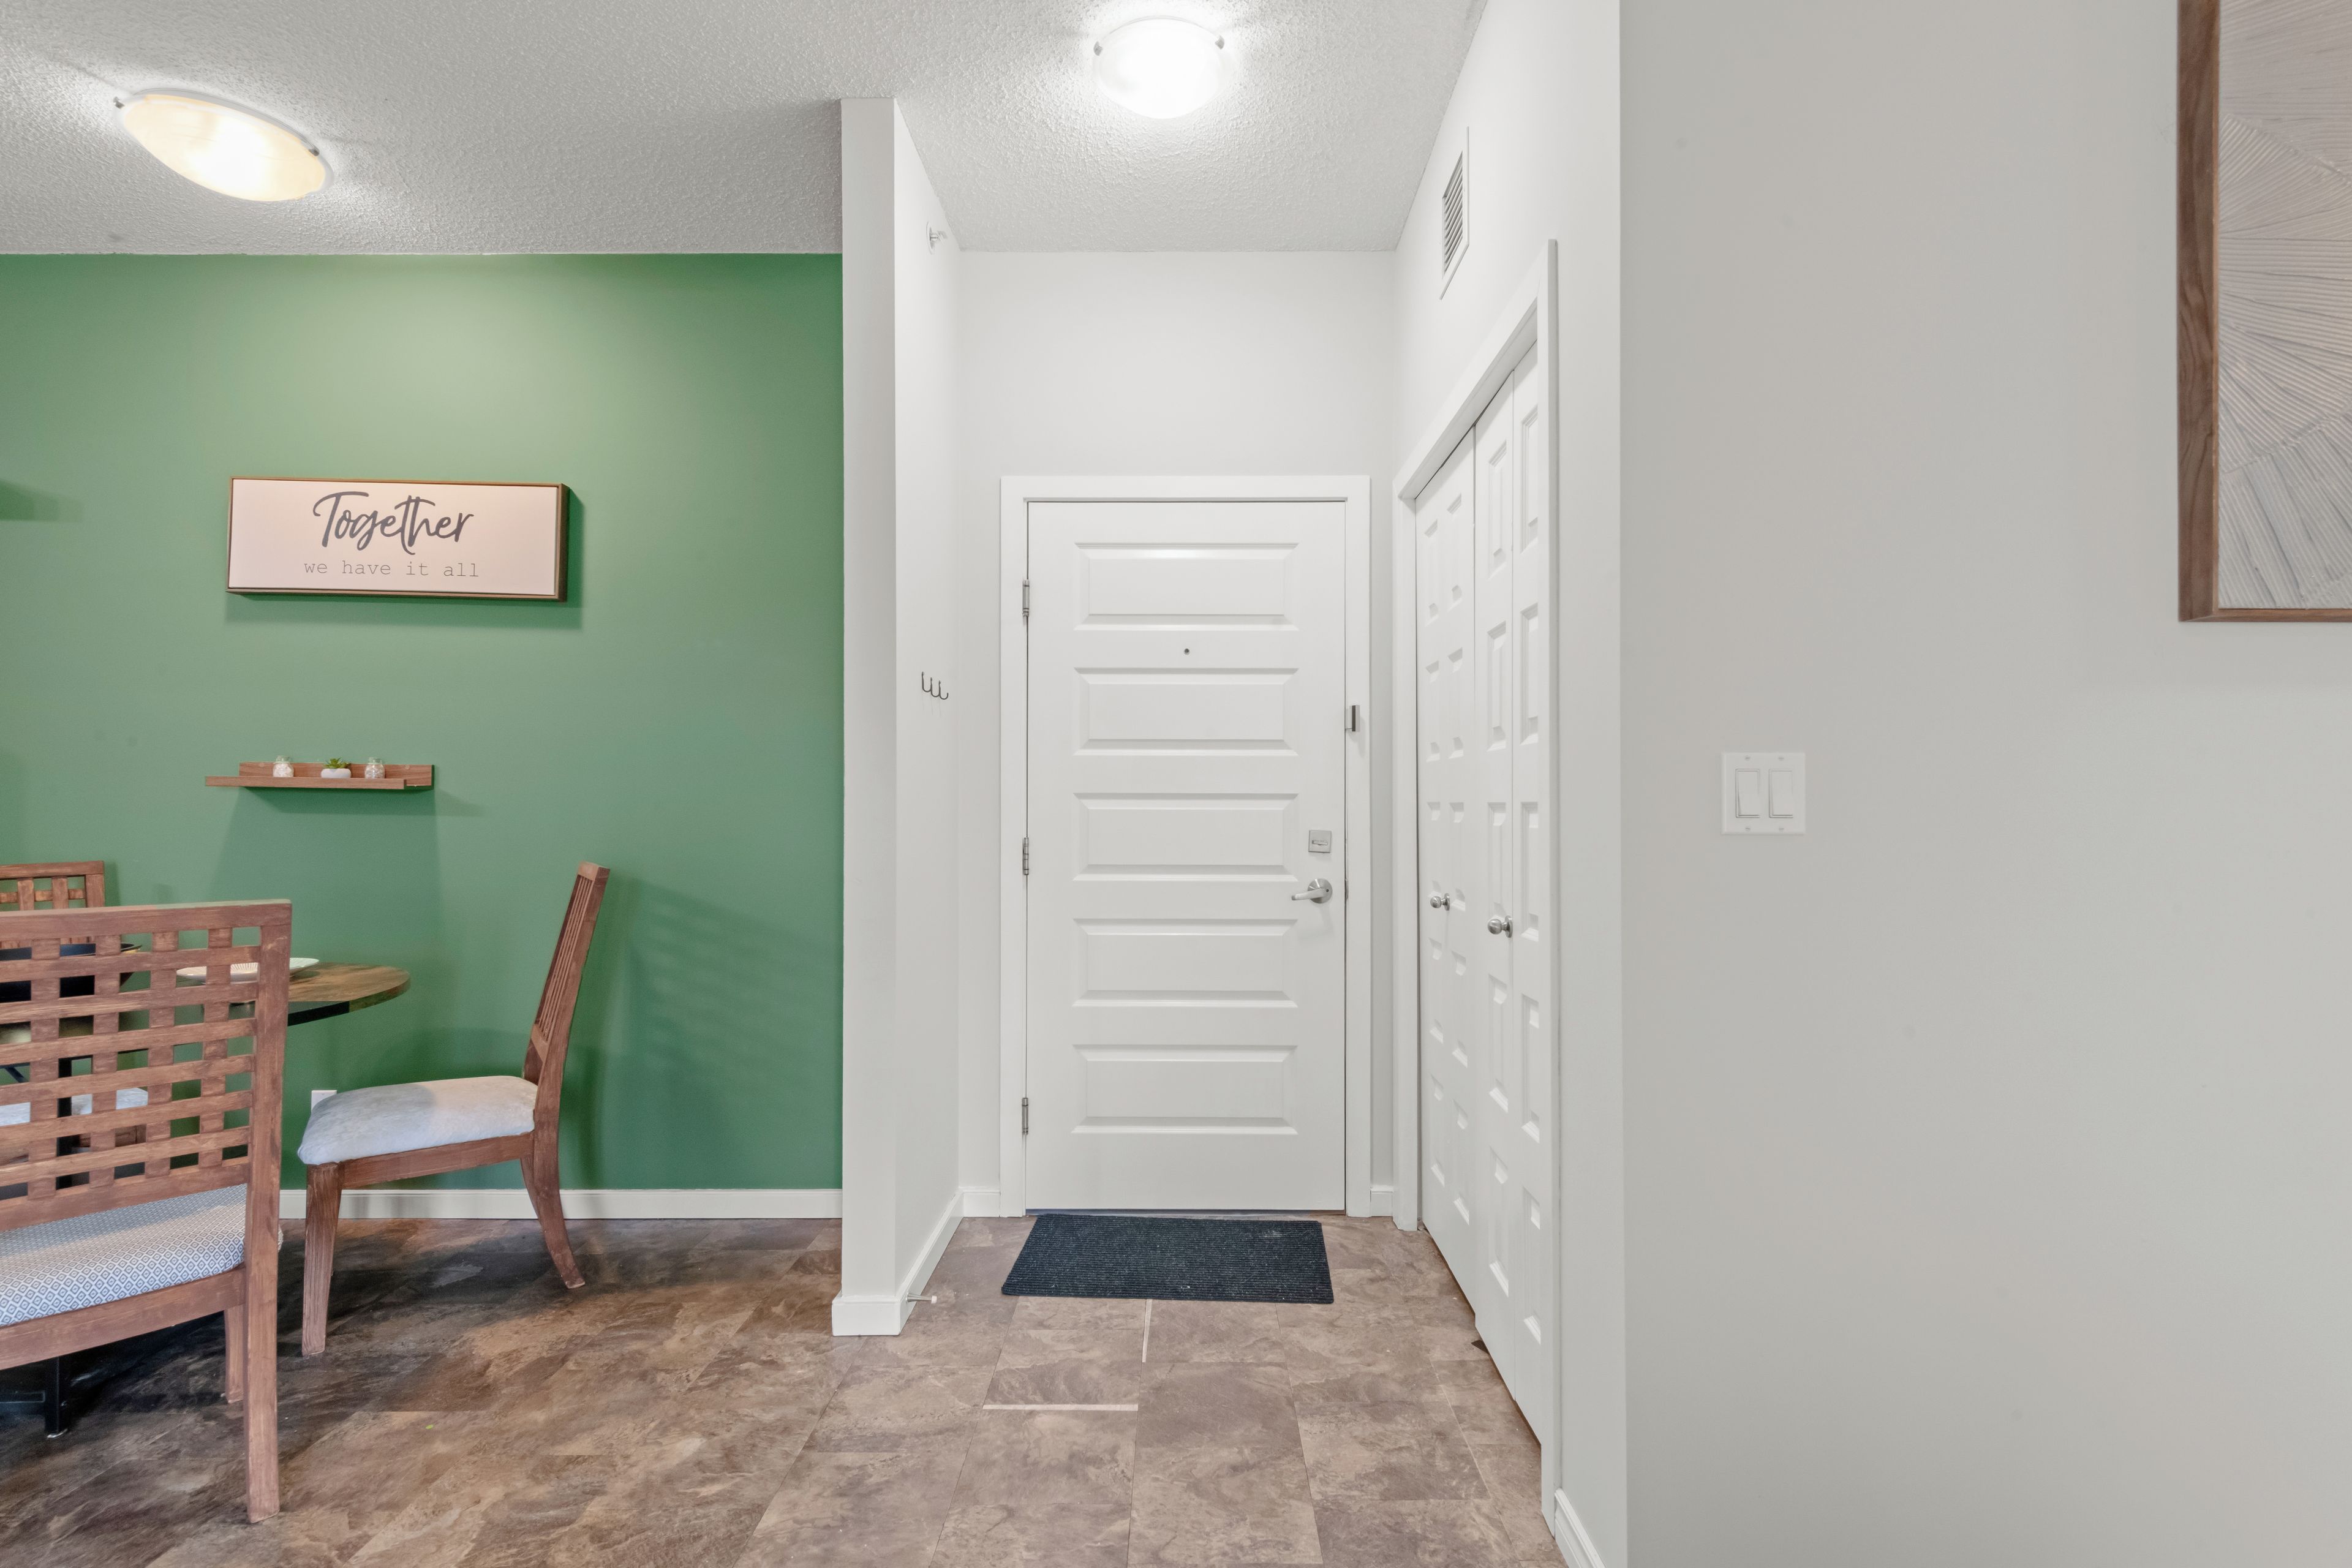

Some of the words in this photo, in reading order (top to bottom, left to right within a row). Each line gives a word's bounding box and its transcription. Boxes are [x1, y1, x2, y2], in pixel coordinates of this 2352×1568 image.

[313, 491, 475, 556] Together
[304, 563, 328, 575] we
[342, 560, 391, 575] have
[406, 561, 429, 576] it
[443, 562, 479, 578] all
